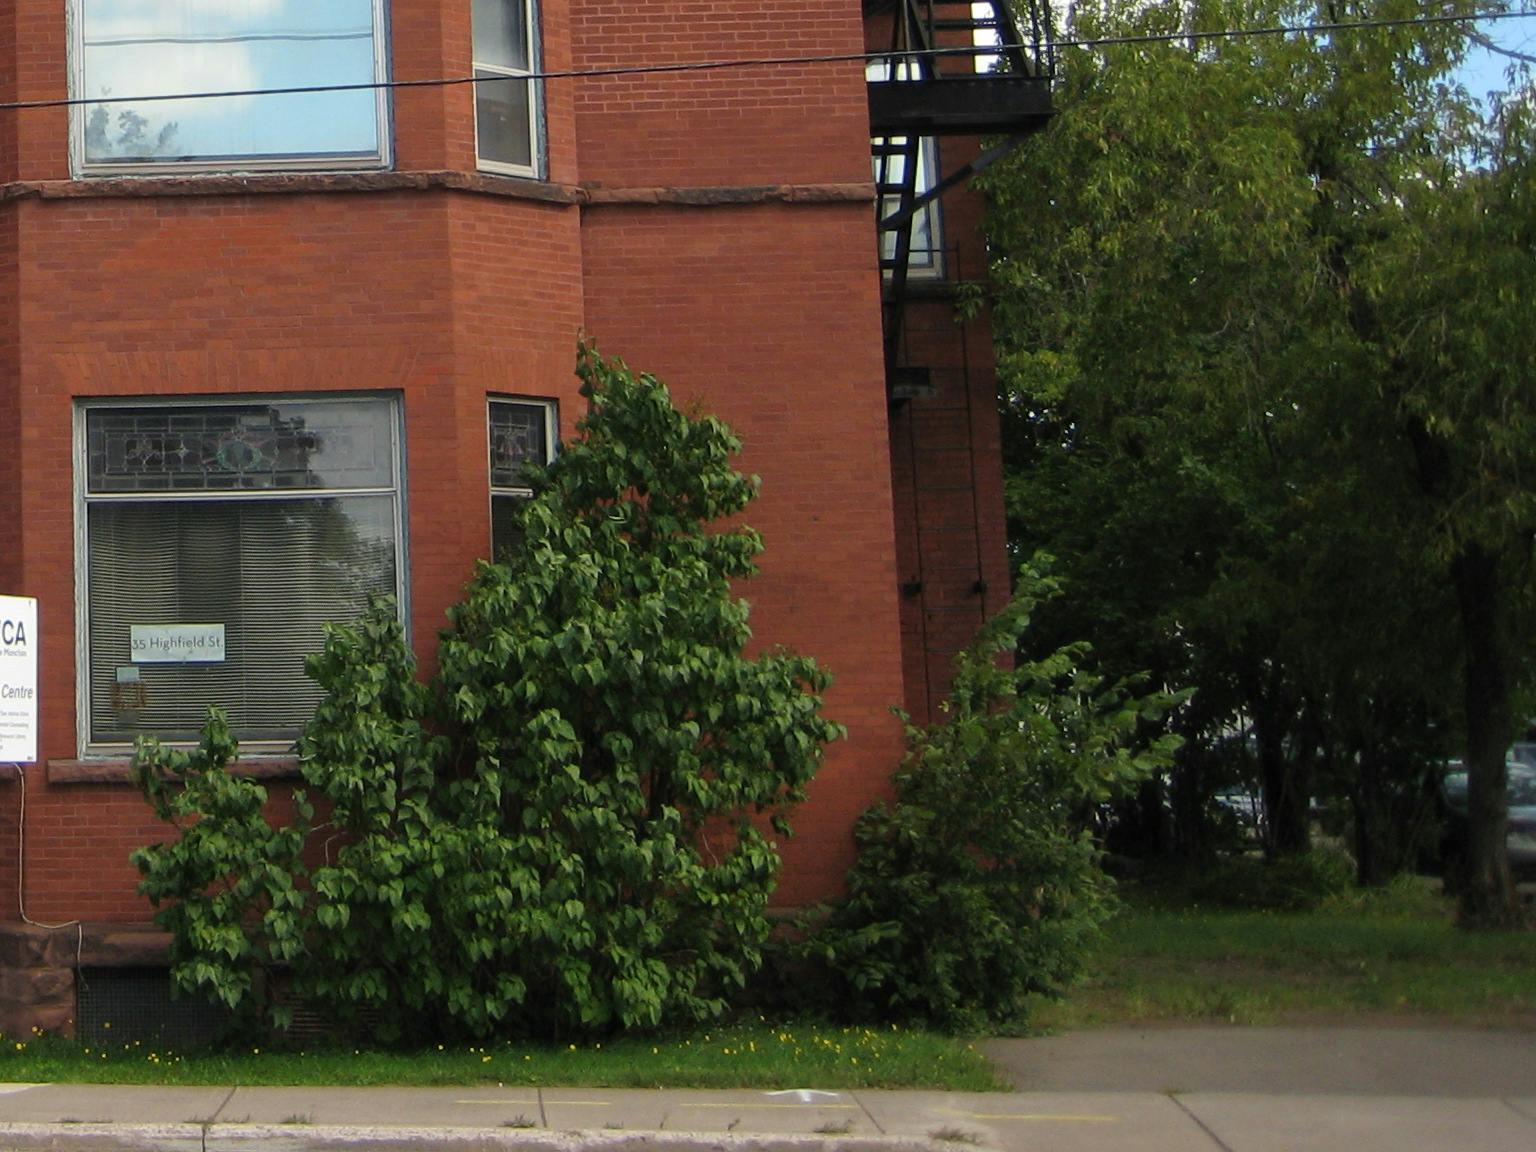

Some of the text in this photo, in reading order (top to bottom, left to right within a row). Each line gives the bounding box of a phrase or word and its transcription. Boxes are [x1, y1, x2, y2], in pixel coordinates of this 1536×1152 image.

[149, 636, 205, 651] Highfield
[208, 635, 224, 648] St.
[1, 683, 34, 699] Centre
